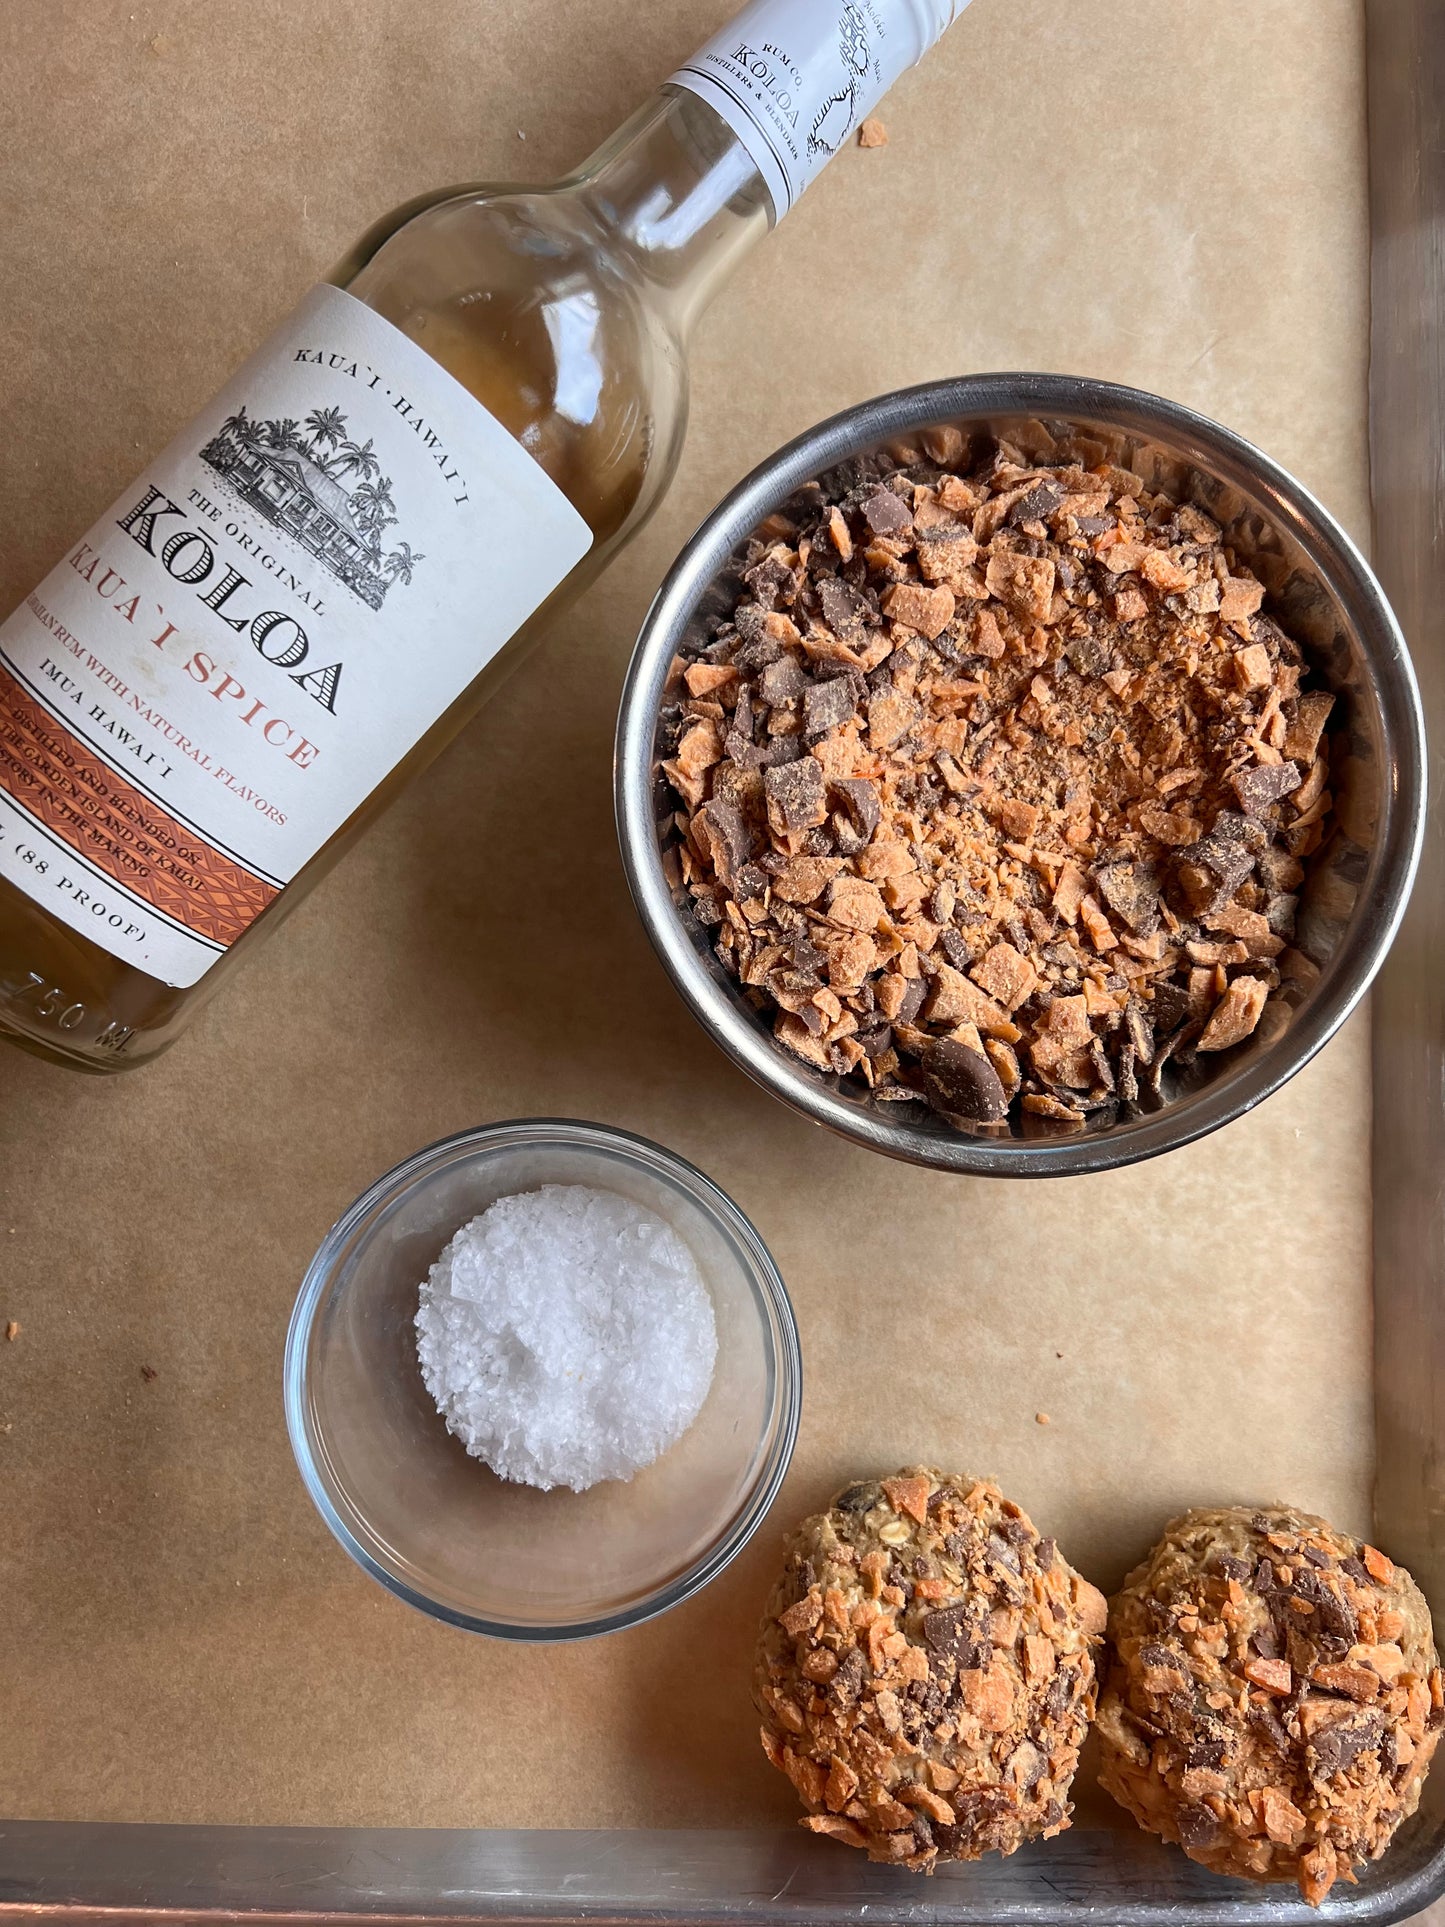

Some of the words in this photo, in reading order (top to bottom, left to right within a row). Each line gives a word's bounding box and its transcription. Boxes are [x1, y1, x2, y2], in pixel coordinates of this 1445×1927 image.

[706, 54, 753, 89] DISTILLERS
[755, 92, 762, 100] &
[765, 104, 799, 160] BLENDERS
[762, 43, 791, 66] RUM
[790, 67, 802, 92] CO.
[187, 489, 223, 522] THE
[225, 522, 326, 616] ORIGINAL
[40, 658, 85, 705] IMUA
[53, 625, 87, 659] RUM
[86, 655, 130, 698] WITH
[127, 695, 212, 770] NATURAL
[213, 766, 288, 826] FLAVORS
[182, 652, 320, 770] SPICE
[0, 722, 25, 749] THE
[24, 747, 81, 798] GARDEN
[81, 797, 134, 842] ISLAND
[136, 841, 157, 857] OF
[12, 709, 75, 768] DISTILLED
[75, 768, 109, 796] AND
[109, 795, 176, 849] BLENDED
[178, 848, 201, 865] ON
[38, 786, 59, 805] IN
[58, 801, 90, 831] THE
[88, 829, 151, 878] MAKING
[15, 843, 49, 874] (88
[57, 876, 146, 942] PROOF)
[13, 971, 85, 1029] 750
